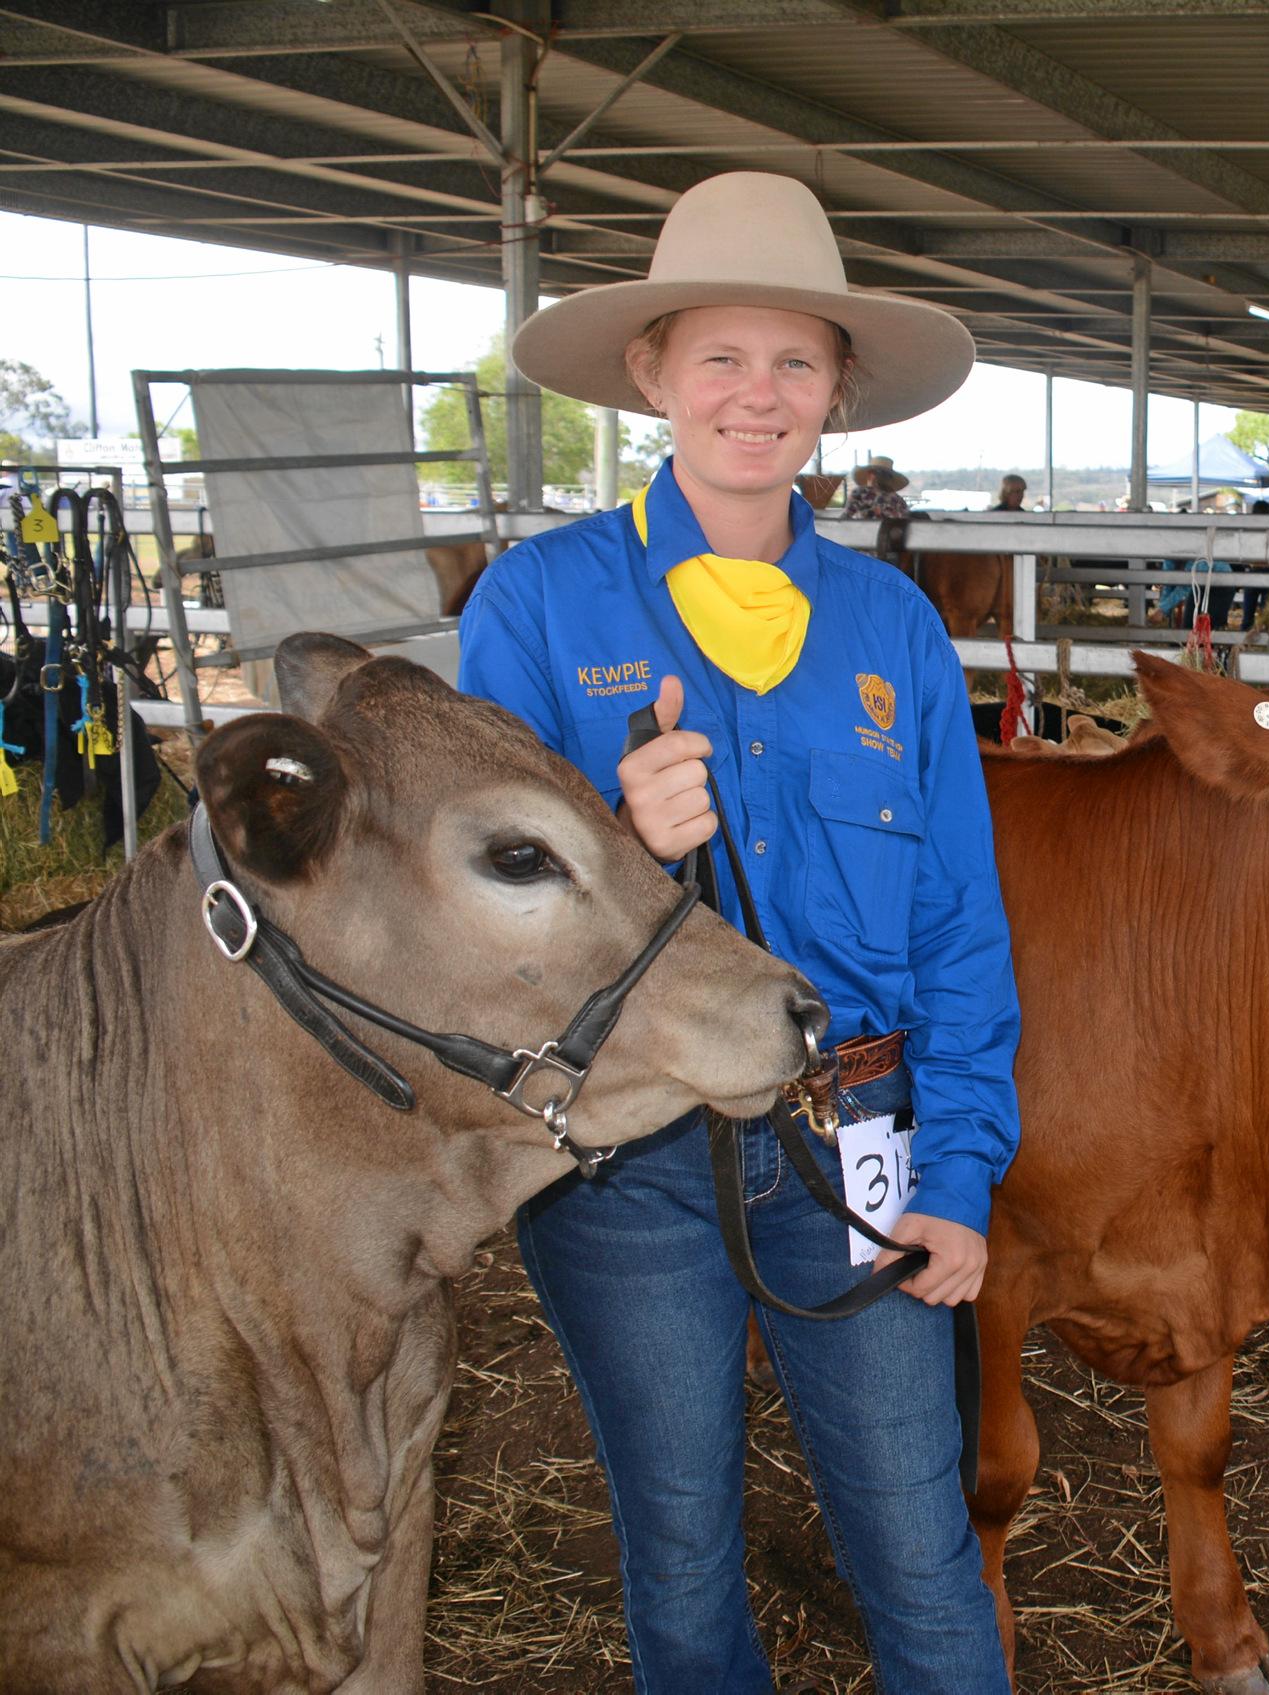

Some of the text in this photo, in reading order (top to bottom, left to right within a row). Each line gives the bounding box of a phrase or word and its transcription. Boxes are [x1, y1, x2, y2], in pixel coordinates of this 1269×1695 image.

[33, 518, 44, 532] 3
[577, 660, 652, 685] KEWPIE
[586, 682, 648, 697] STOCKFEEDS
[860, 736, 884, 752] SHOW
